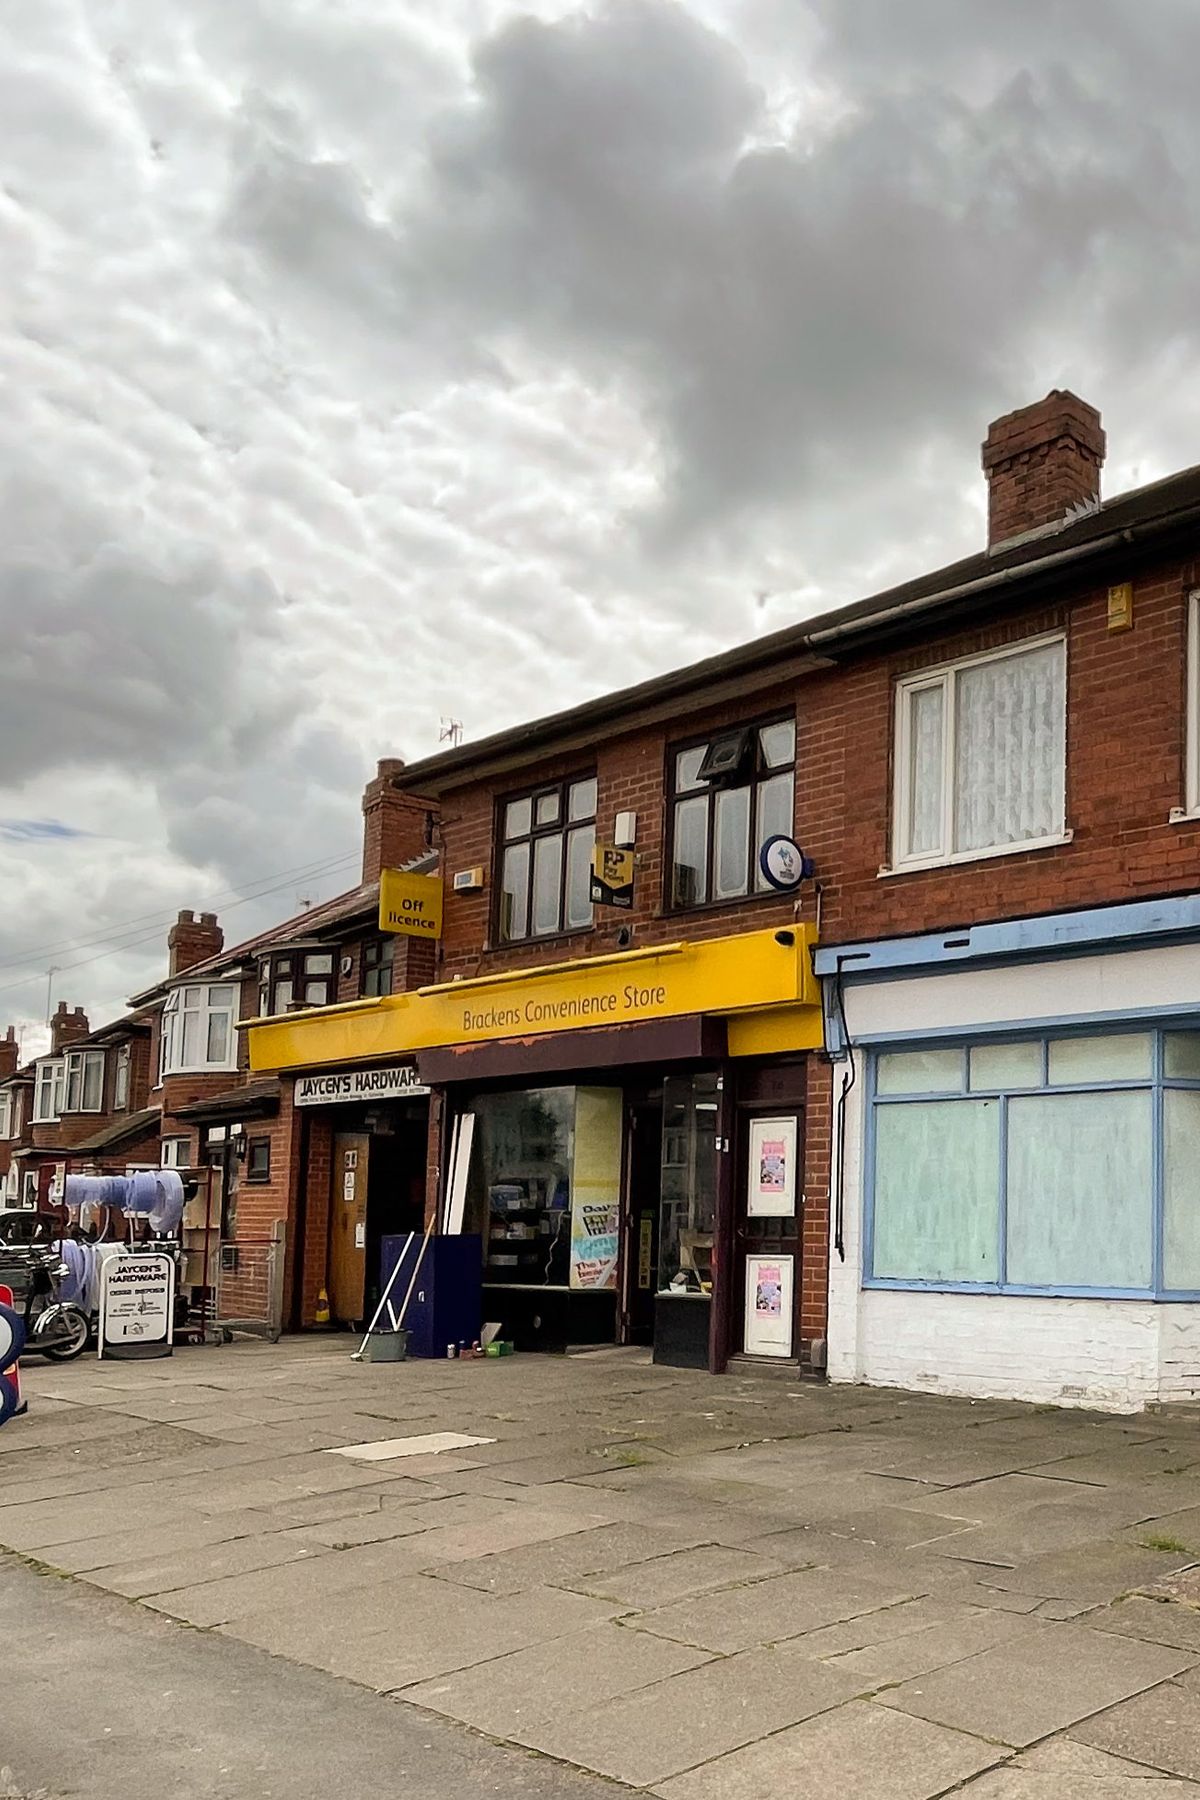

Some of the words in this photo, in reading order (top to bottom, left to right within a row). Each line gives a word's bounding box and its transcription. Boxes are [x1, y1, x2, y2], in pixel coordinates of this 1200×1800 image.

[402, 898, 424, 912] Off
[388, 911, 436, 930] licence
[463, 1007, 521, 1031] Brackens
[525, 993, 617, 1022] Convenience
[623, 985, 666, 1009] Store
[300, 1075, 351, 1097] JAYCEN'S
[355, 1068, 418, 1092] HARDWAR
[109, 1273, 167, 1283] HARDWARE
